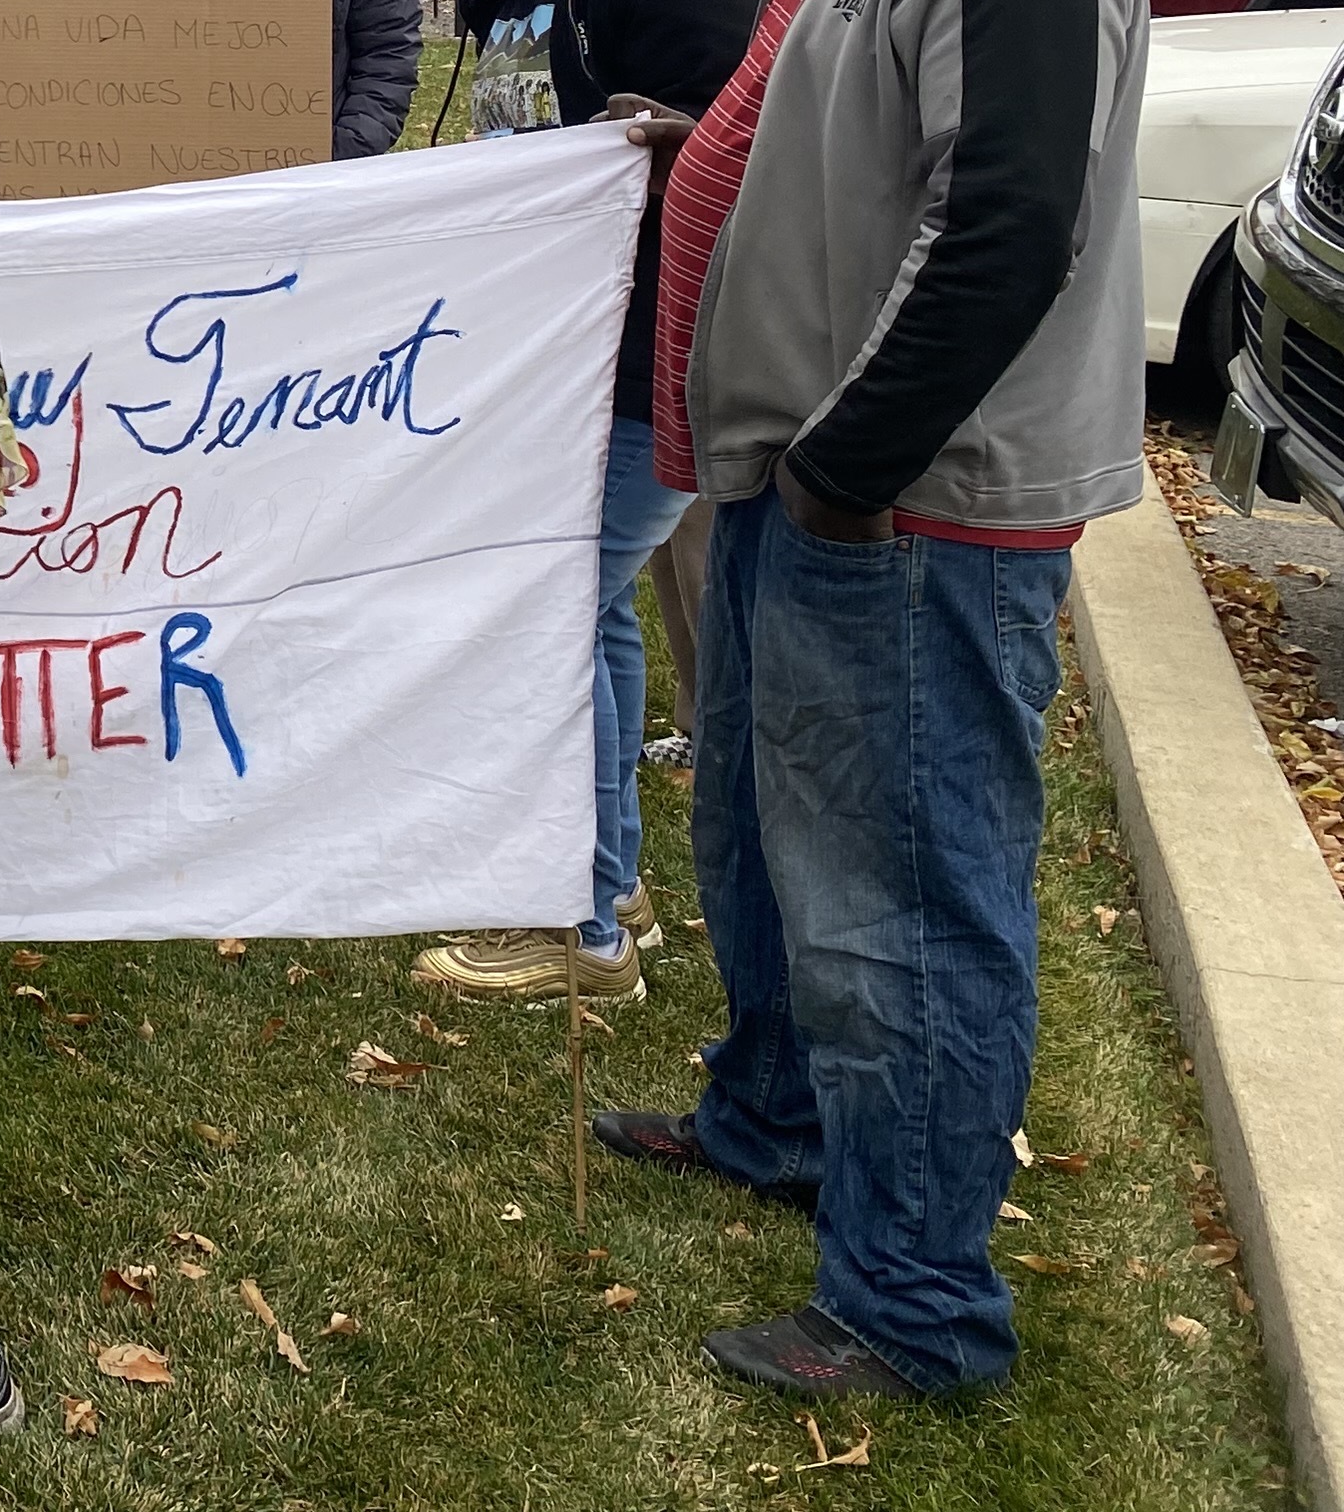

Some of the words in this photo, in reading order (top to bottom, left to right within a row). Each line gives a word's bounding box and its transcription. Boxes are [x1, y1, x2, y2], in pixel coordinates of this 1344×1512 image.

[65, 14, 146, 43] VIDA
[173, 19, 288, 50] MEJOR
[208, 80, 255, 112] EN
[262, 81, 328, 117] QUE
[149, 143, 318, 175] NUESTRAS
[106, 273, 467, 455] Tenant
